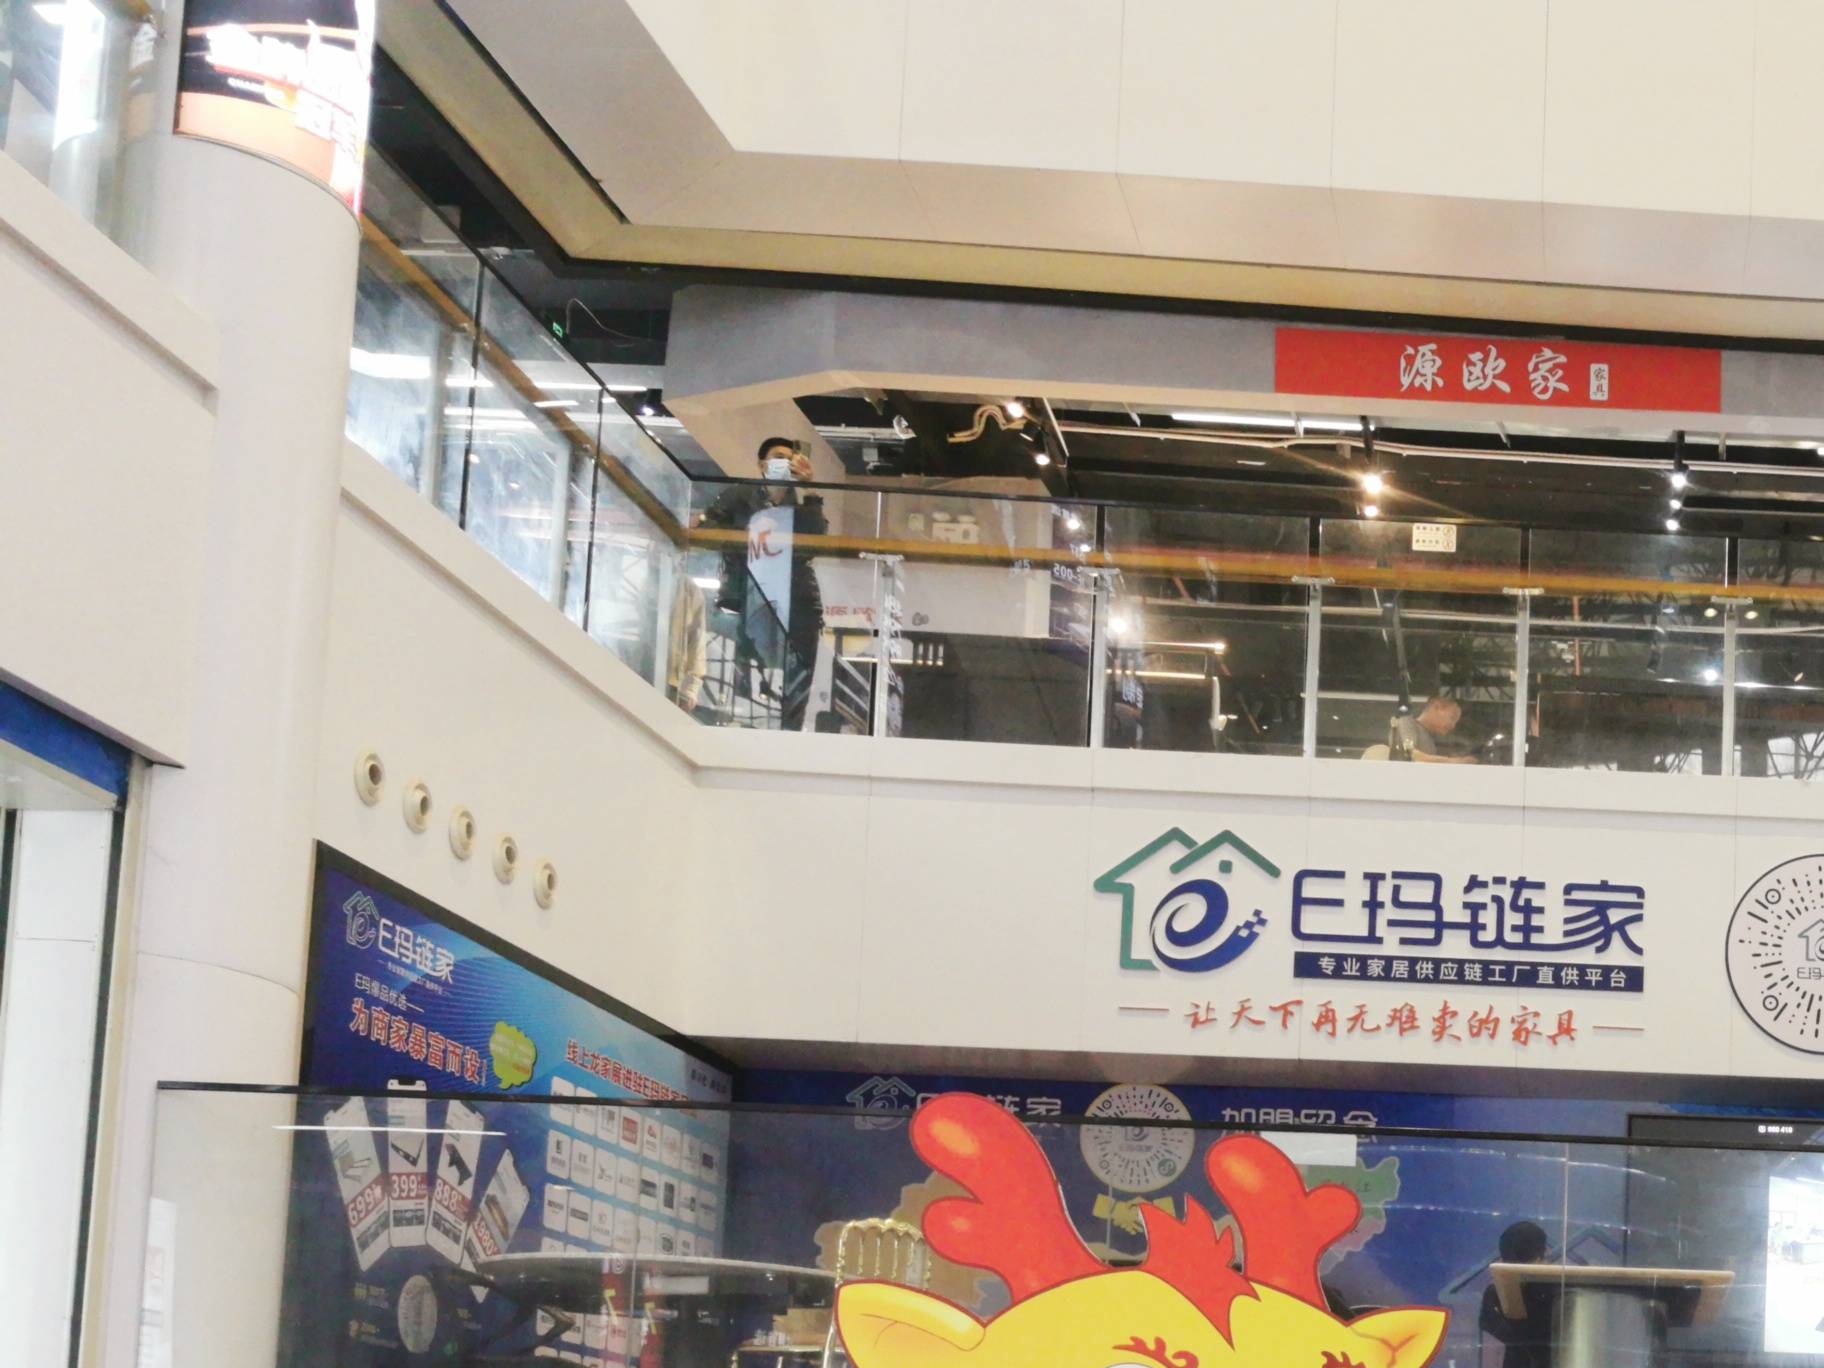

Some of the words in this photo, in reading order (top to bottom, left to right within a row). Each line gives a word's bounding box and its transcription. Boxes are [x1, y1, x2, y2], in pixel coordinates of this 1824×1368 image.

[1400, 343, 1570, 400] 源欧家
[1291, 868, 1646, 957] E玛链家
[1317, 956, 1628, 989] 专业家居供应链工厂直供平台
[1183, 998, 1579, 1047] 让天下再无难卖的家具
[391, 1175, 418, 1199] 399
